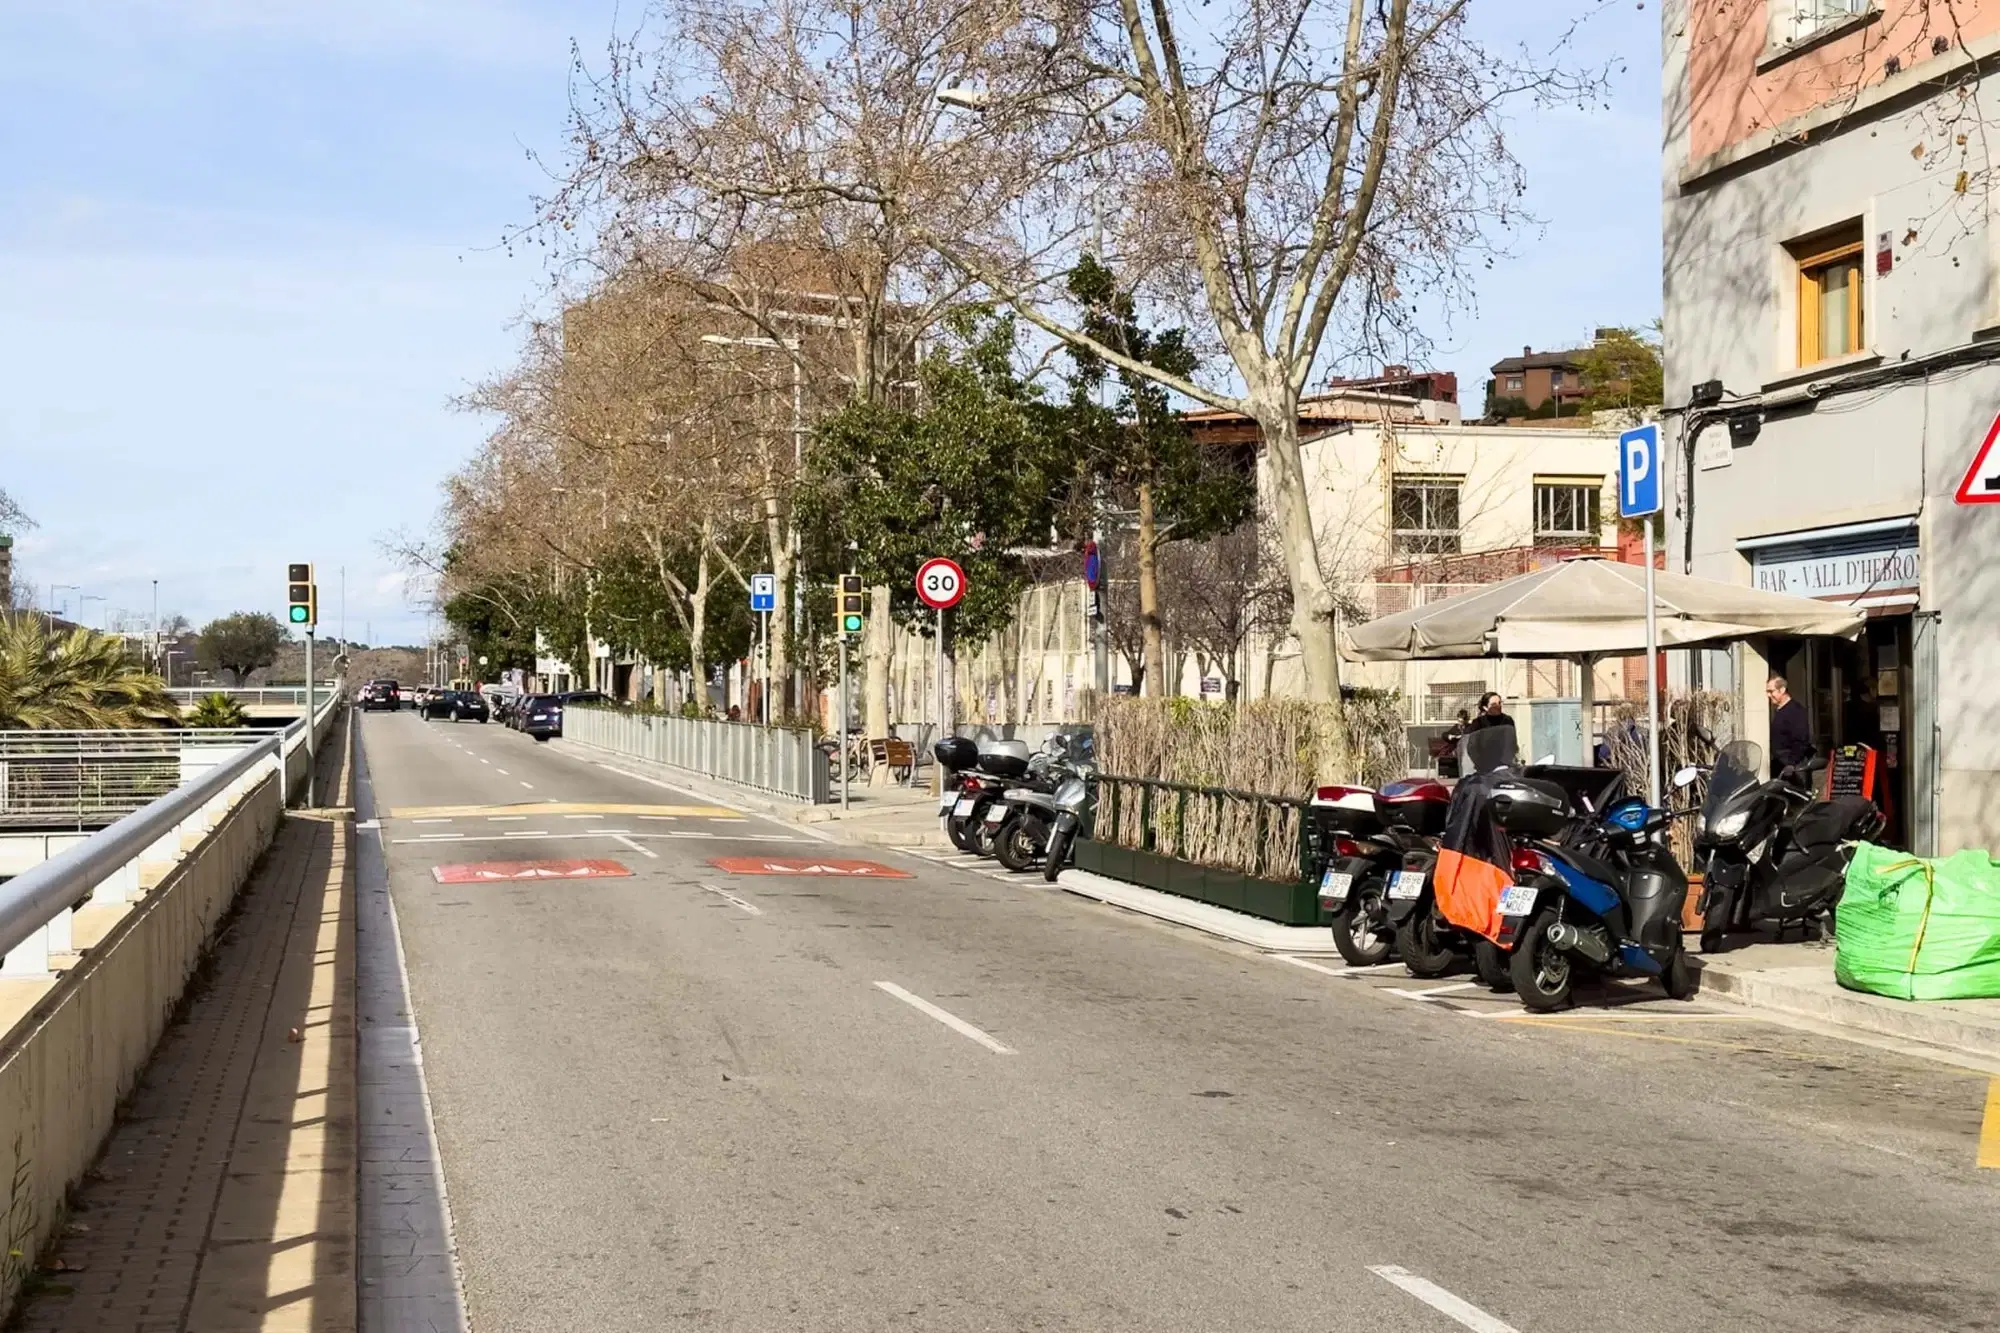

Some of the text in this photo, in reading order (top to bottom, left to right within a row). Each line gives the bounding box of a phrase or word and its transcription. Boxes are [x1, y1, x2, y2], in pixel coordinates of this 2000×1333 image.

[1627, 438, 1650, 506] P
[927, 574, 954, 591] 30
[1760, 568, 1787, 592] BAR
[1803, 562, 1841, 588] VALL
